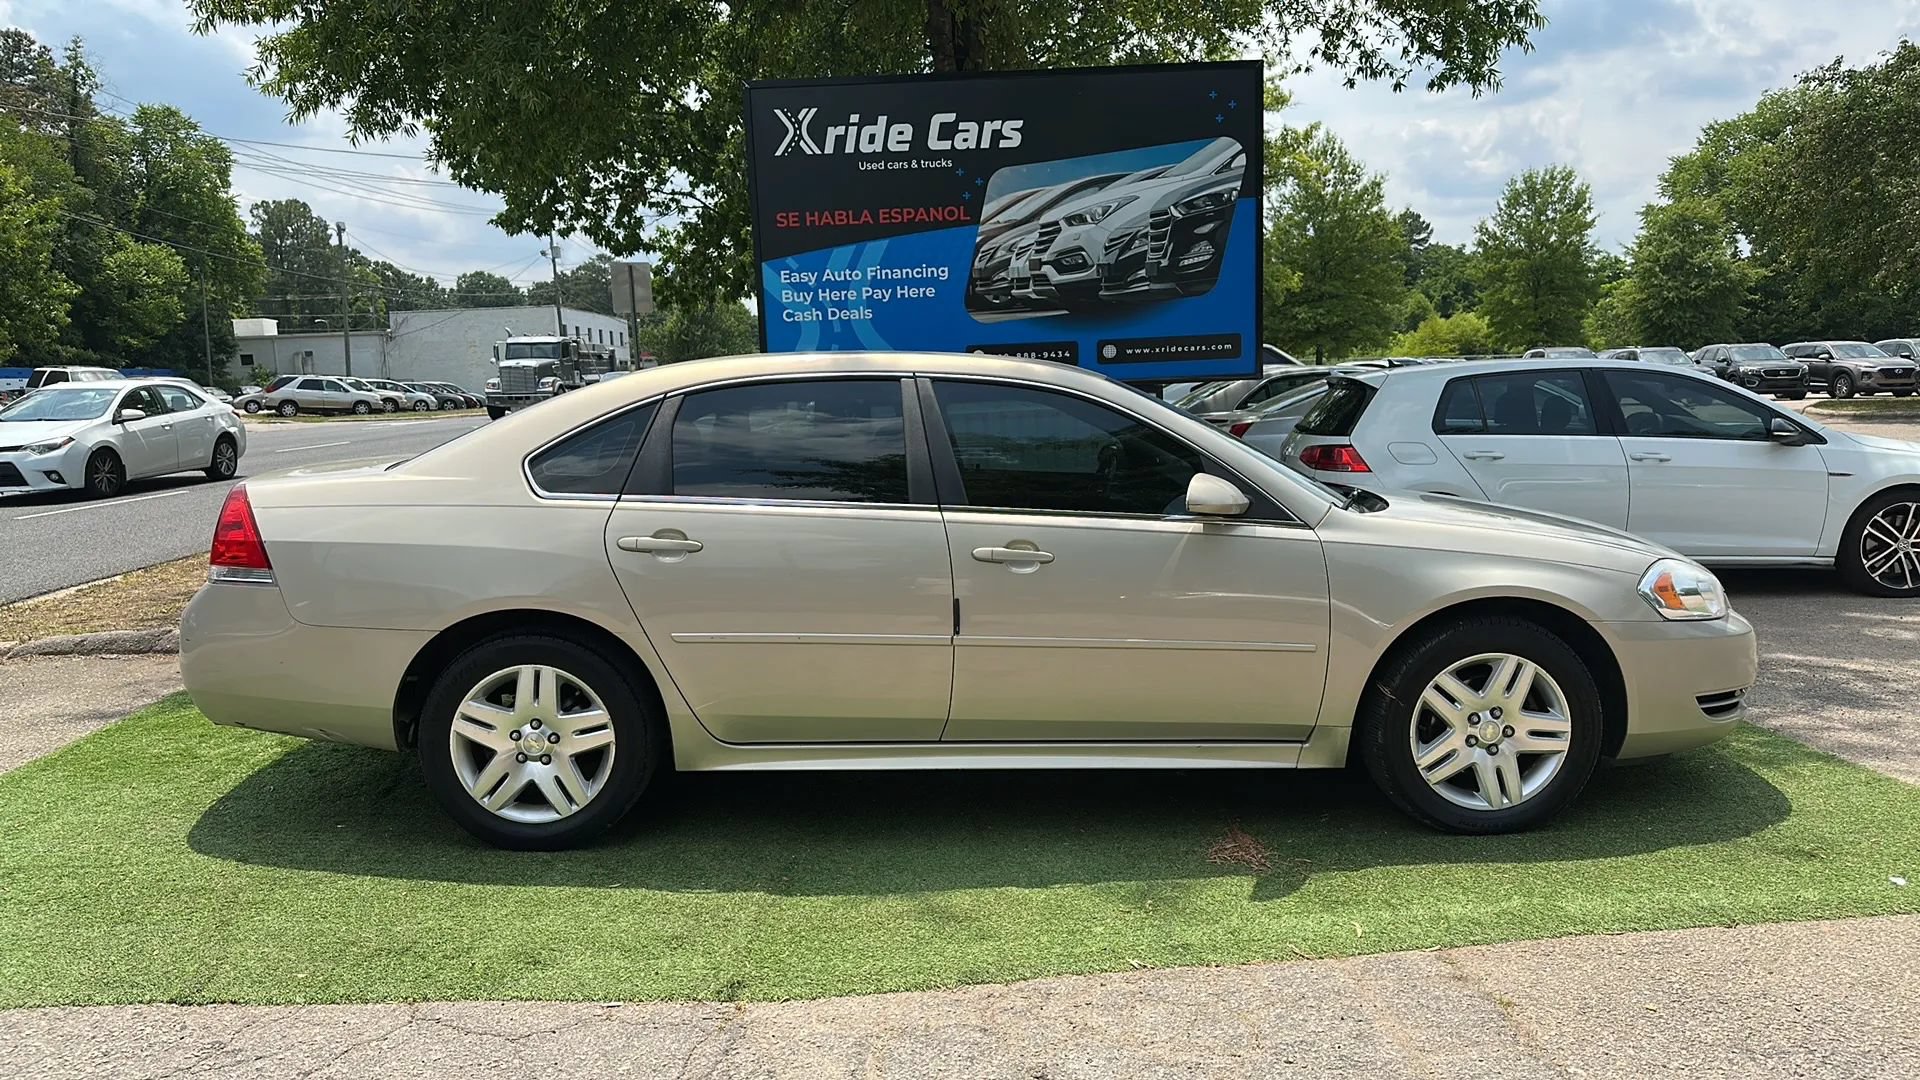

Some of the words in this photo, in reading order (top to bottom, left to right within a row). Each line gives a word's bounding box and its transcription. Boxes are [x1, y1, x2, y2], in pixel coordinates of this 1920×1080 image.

[927, 112, 1024, 151] Cars
[858, 161, 885, 171] Used
[887, 160, 908, 169] cars
[911, 159, 918, 168] &
[920, 158, 953, 168] trucks
[776, 211, 800, 228] SE
[805, 209, 873, 226] HABLA
[879, 205, 971, 223] ESPANOL
[780, 270, 818, 286] Easy
[822, 268, 862, 282] Auto
[866, 264, 949, 280] Financing
[781, 290, 813, 305] Buy
[818, 288, 857, 301] Here
[861, 287, 892, 302] Pay
[896, 285, 936, 298] Here
[782, 309, 823, 322] Cash
[827, 306, 873, 321] Deals
[1125, 342, 1233, 355] www.xridecars.com
